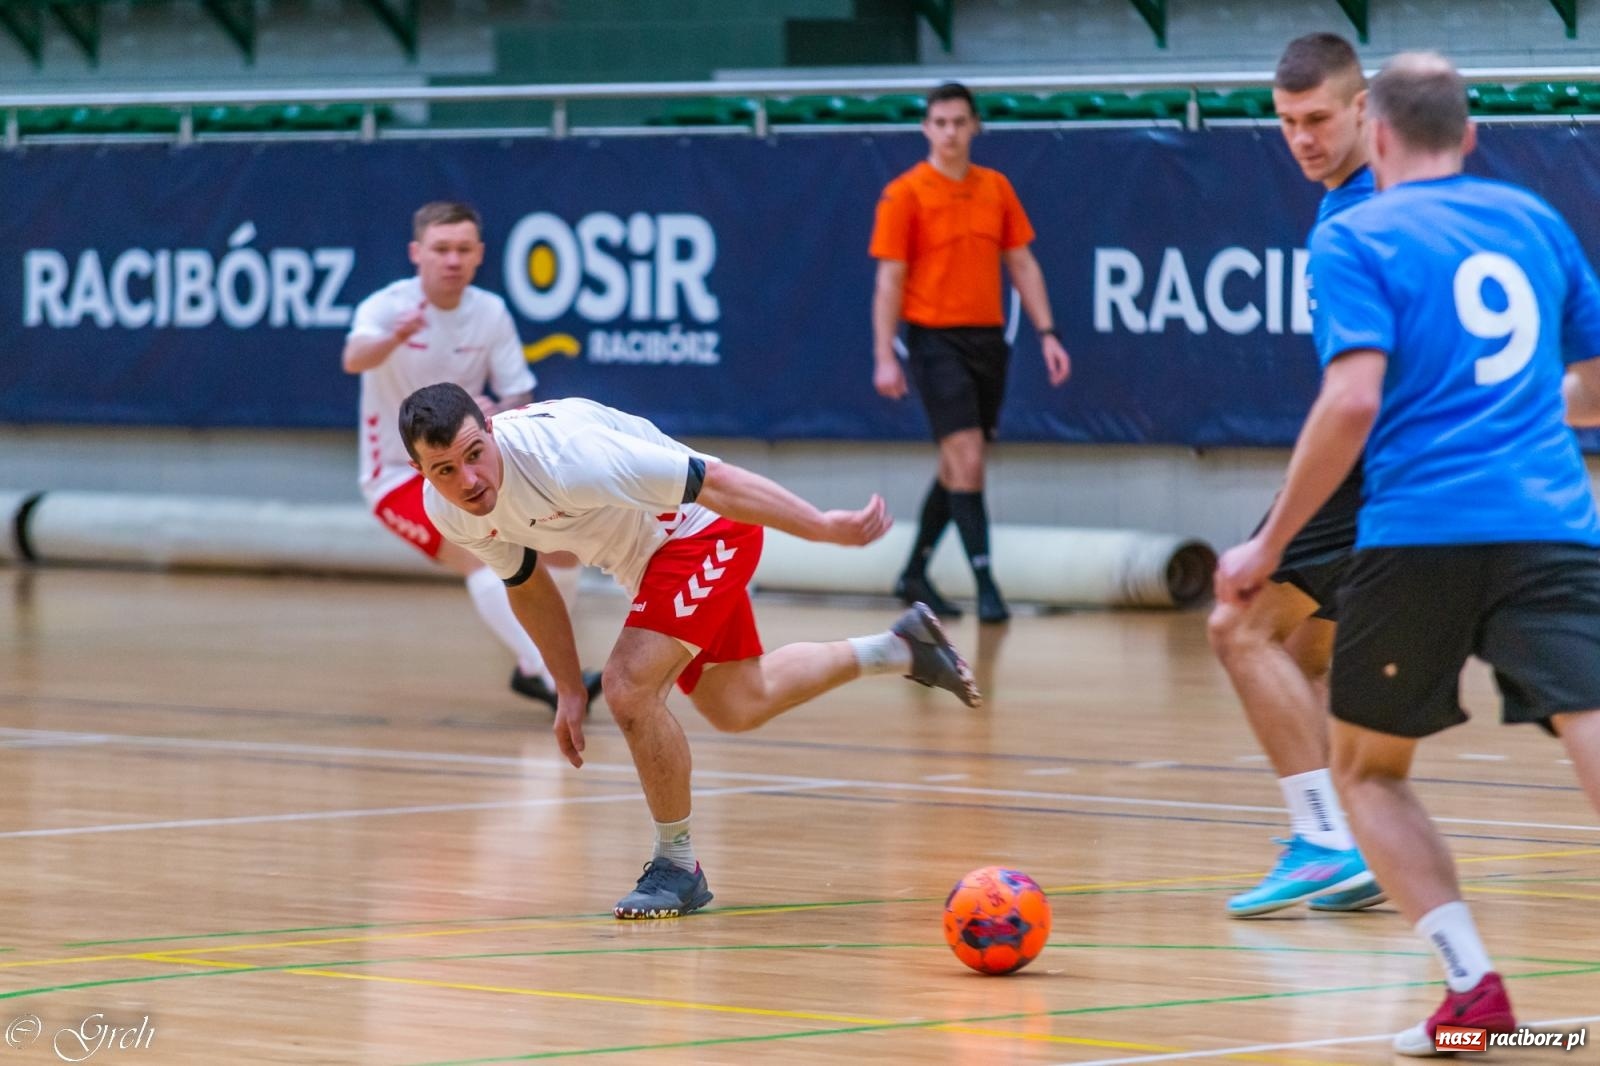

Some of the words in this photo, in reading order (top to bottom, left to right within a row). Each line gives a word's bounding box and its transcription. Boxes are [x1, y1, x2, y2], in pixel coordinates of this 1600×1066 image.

[23, 221, 355, 329] RACIBÓRZ
[1453, 251, 1540, 386] 9
[588, 323, 721, 365] RACIBÓRZ
